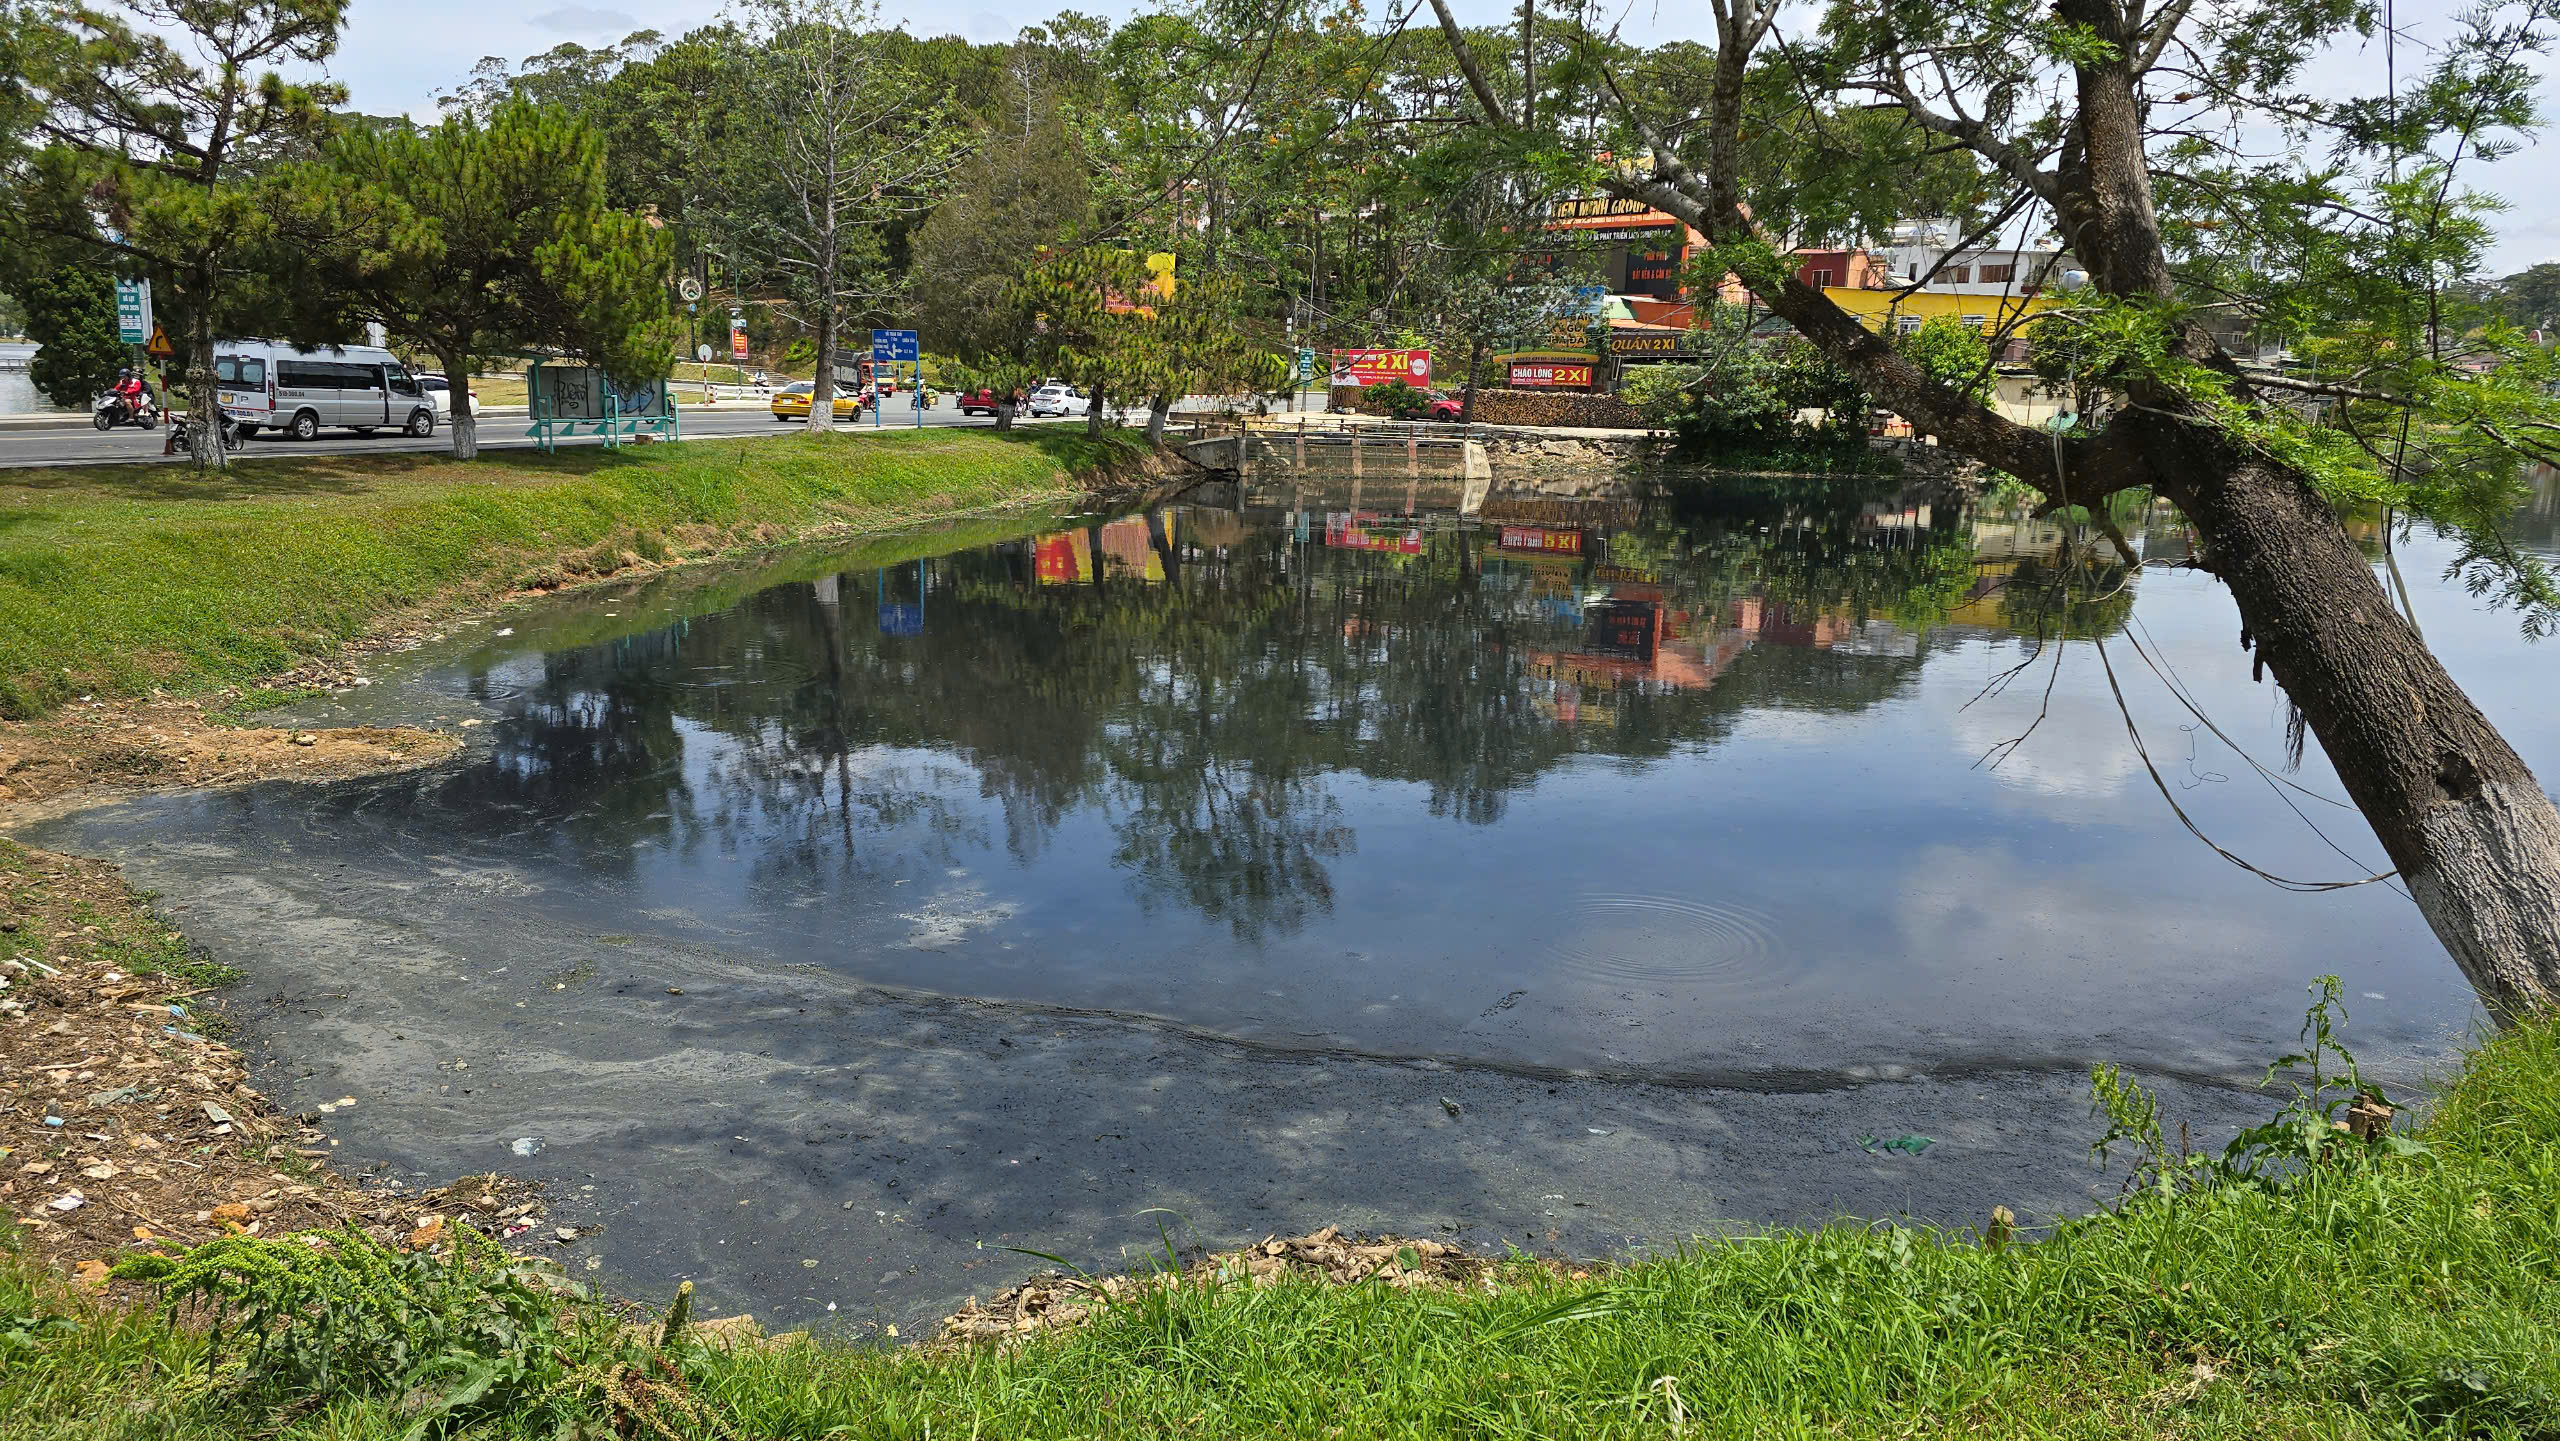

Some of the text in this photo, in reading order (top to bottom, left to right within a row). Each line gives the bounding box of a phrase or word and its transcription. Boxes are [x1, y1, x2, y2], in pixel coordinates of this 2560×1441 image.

[1611, 199, 1646, 213] GROUP
[1611, 336, 1652, 352] QUÁN
[1377, 354, 1387, 369] 2
[1391, 352, 1408, 370] XÍ
[1512, 366, 1589, 381] CHÁO LÒNG 2 XÍ
